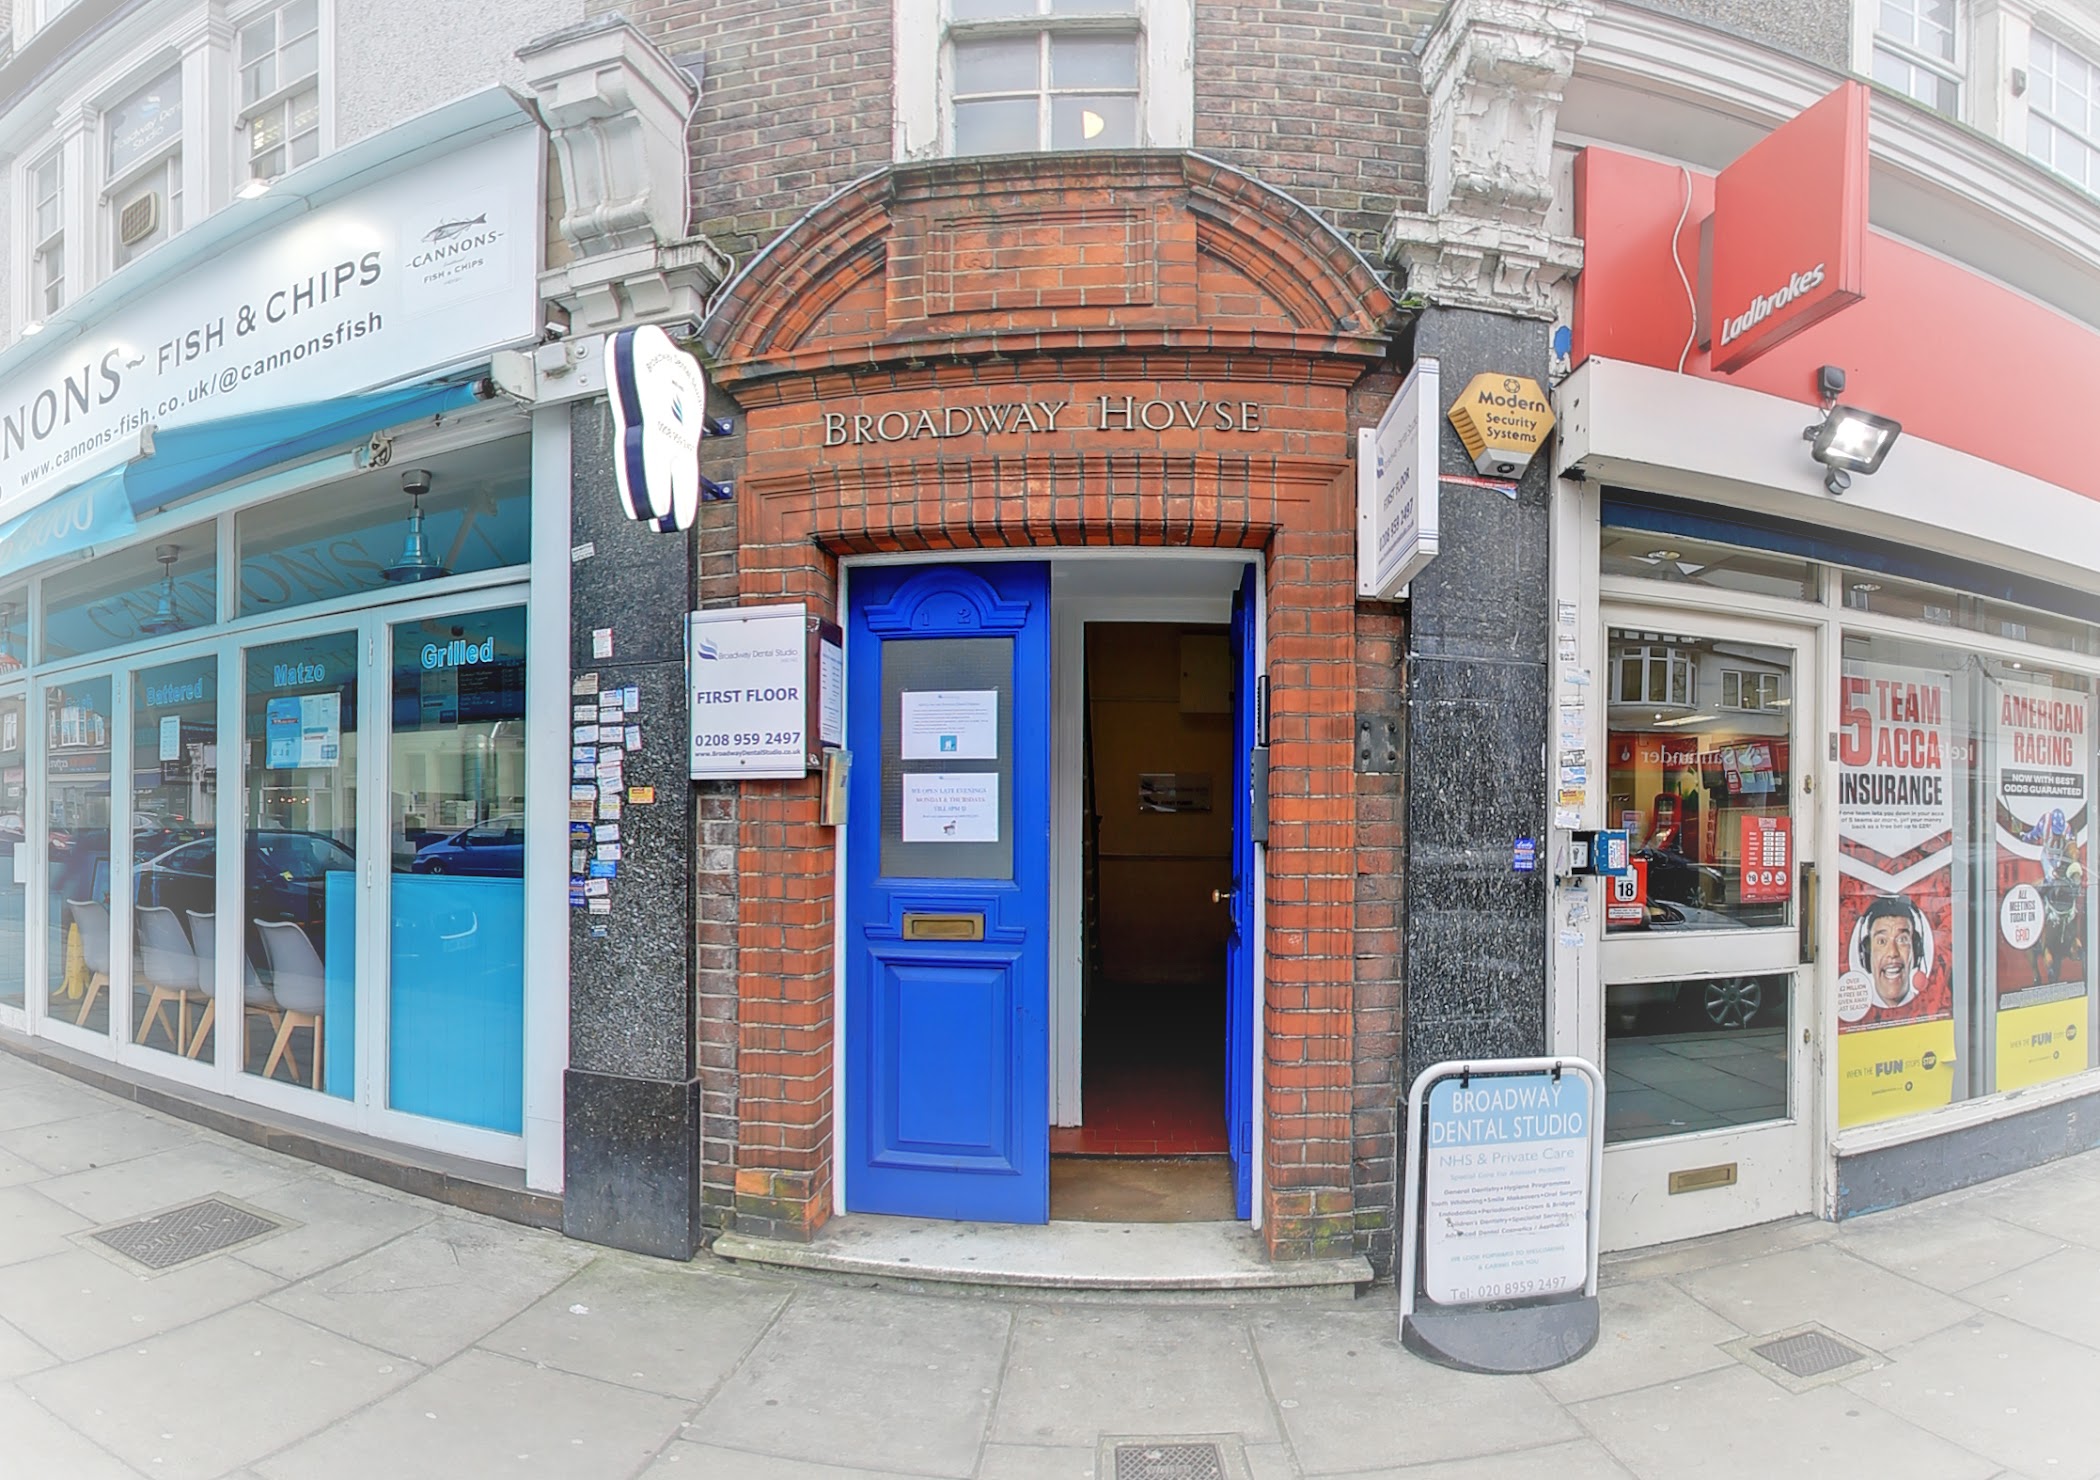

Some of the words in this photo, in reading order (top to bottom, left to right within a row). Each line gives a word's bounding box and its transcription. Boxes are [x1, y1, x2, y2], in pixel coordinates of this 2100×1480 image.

[412, 230, 497, 268] CANNONS
[424, 270, 445, 284] FISH
[454, 258, 484, 273] CHIPS
[158, 317, 224, 376] FISH
[236, 304, 256, 337] &
[266, 251, 382, 324] CHIPS
[1720, 262, 1826, 347] Ladbrokes
[20, 311, 383, 487] www.cannons-fish.co.uk/@cannonsfish
[1478, 391, 1546, 413] Modern
[823, 400, 1069, 447] BROADWAY
[1098, 395, 1262, 433] HOVSE
[1486, 412, 1538, 431] Security
[1487, 426, 1537, 443] Systems
[421, 636, 494, 669] Grilled
[752, 649, 773, 658] Dental
[775, 648, 798, 657] Studio
[273, 662, 325, 688] Matzo
[146, 678, 203, 707] Battered
[697, 690, 742, 704] FIRST
[747, 687, 799, 702] FLOOR
[1840, 676, 1872, 767] 5
[1875, 680, 1941, 725] TEAM
[2001, 694, 2083, 735] AMERICAN
[695, 734, 730, 747] 0208
[733, 733, 760, 746] 959
[765, 732, 801, 745] 2497
[1877, 727, 1942, 769] ACCA
[2014, 731, 2073, 767] RACING
[1839, 773, 1942, 806] INSURANCE
[2004, 784, 2029, 793] ODDS
[2029, 786, 2082, 796] GUARANTEED
[2012, 774, 2033, 783] NOW
[2034, 775, 2054, 784] WITH
[2055, 777, 2076, 786] BEST
[1618, 882, 1634, 897] 18
[2018, 890, 2027, 899] ALL
[2009, 900, 2036, 911] MEETINGS
[2010, 912, 2027, 923] TODAY
[2028, 911, 2036, 921] ON
[2031, 1032, 2052, 1047] FUN
[1846, 1070, 1862, 1079] WHEN
[1864, 1067, 1873, 1076] THE
[1875, 1060, 1903, 1077] FUN
[1922, 1056, 1935, 1066] STOP
[1452, 1085, 1562, 1114] BROADWAY
[1432, 1118, 1507, 1144] DENTAL
[1513, 1112, 1583, 1138] STUDIO
[1439, 1154, 1473, 1167] NHS
[1477, 1154, 1487, 1165] &
[1493, 1150, 1538, 1165] Private
[1542, 1147, 1575, 1160] Care
[1444, 1188, 1470, 1196] General
[1471, 1185, 1500, 1194] Dentistry
[1504, 1183, 1530, 1192] Hygiene
[1560, 1189, 1583, 1197] Surgery
[1445, 1230, 1477, 1239] Advced
[1450, 1288, 1475, 1300] Tel:
[1478, 1284, 1501, 1298] 020
[1504, 1280, 1534, 1295] 8959
[1538, 1276, 1567, 1290] 2497
